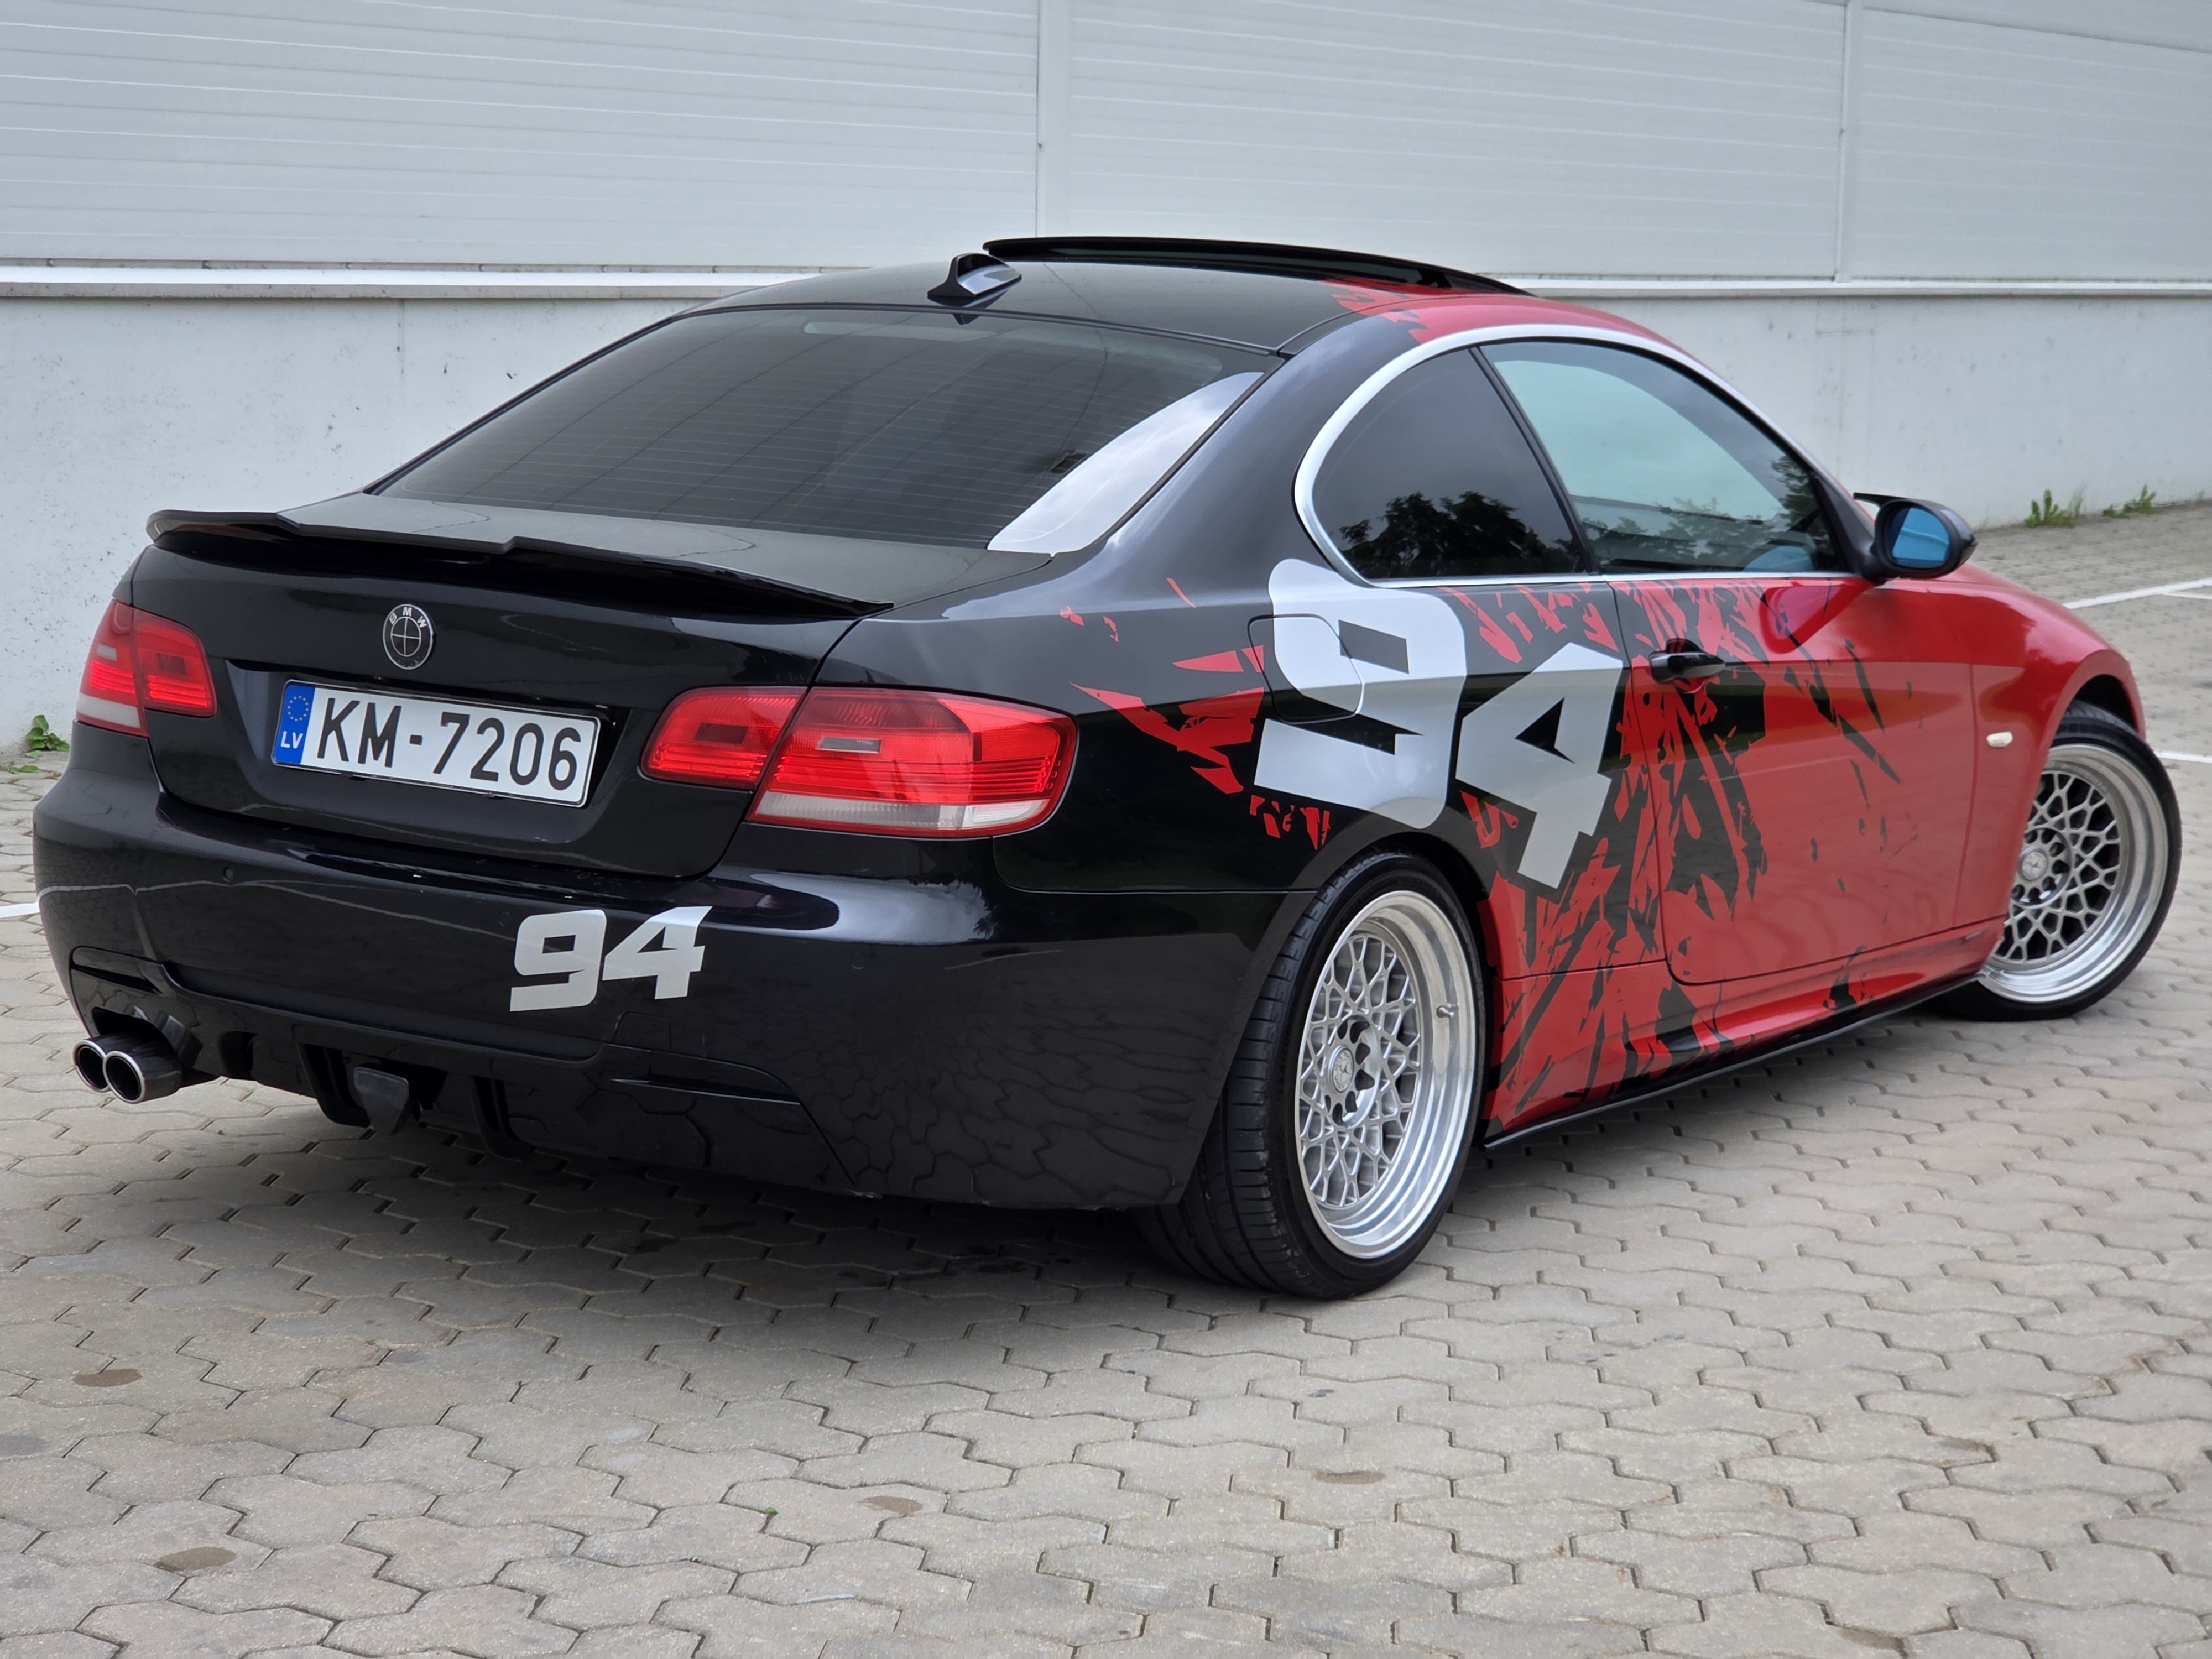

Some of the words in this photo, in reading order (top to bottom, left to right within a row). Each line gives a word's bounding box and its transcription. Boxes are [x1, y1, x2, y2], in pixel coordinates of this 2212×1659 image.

[389, 607, 427, 628] BMW
[280, 731, 304, 749] LV
[317, 697, 581, 791] KM-7206
[1253, 558, 1623, 889] 94
[509, 906, 713, 1012] 94
